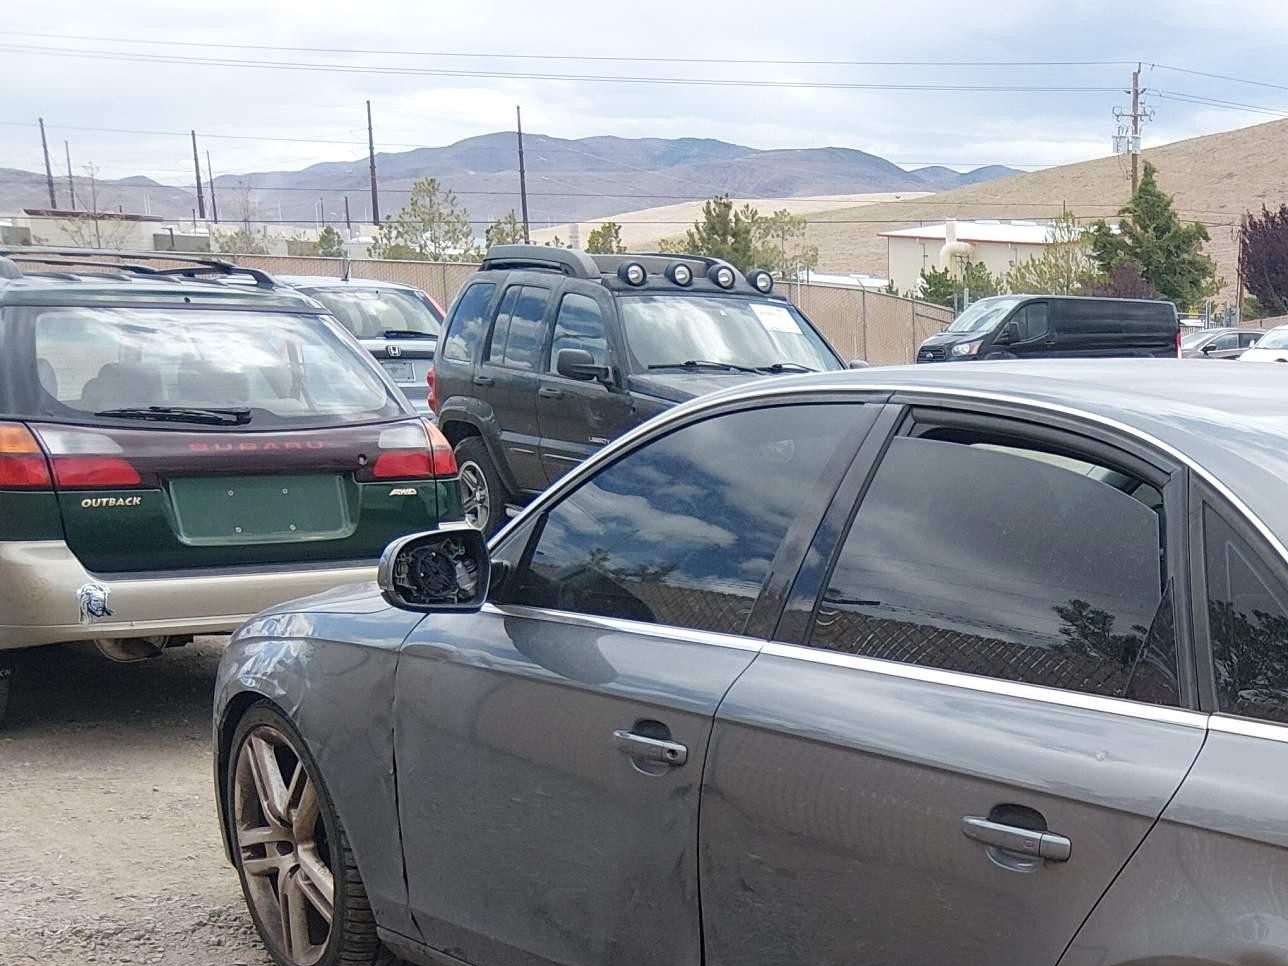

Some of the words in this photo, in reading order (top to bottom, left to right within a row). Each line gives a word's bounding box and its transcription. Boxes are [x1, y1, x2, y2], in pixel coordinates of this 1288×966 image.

[189, 441, 324, 452] SUBARU
[389, 488, 418, 496] AWD
[81, 496, 142, 508] OUTBACK
